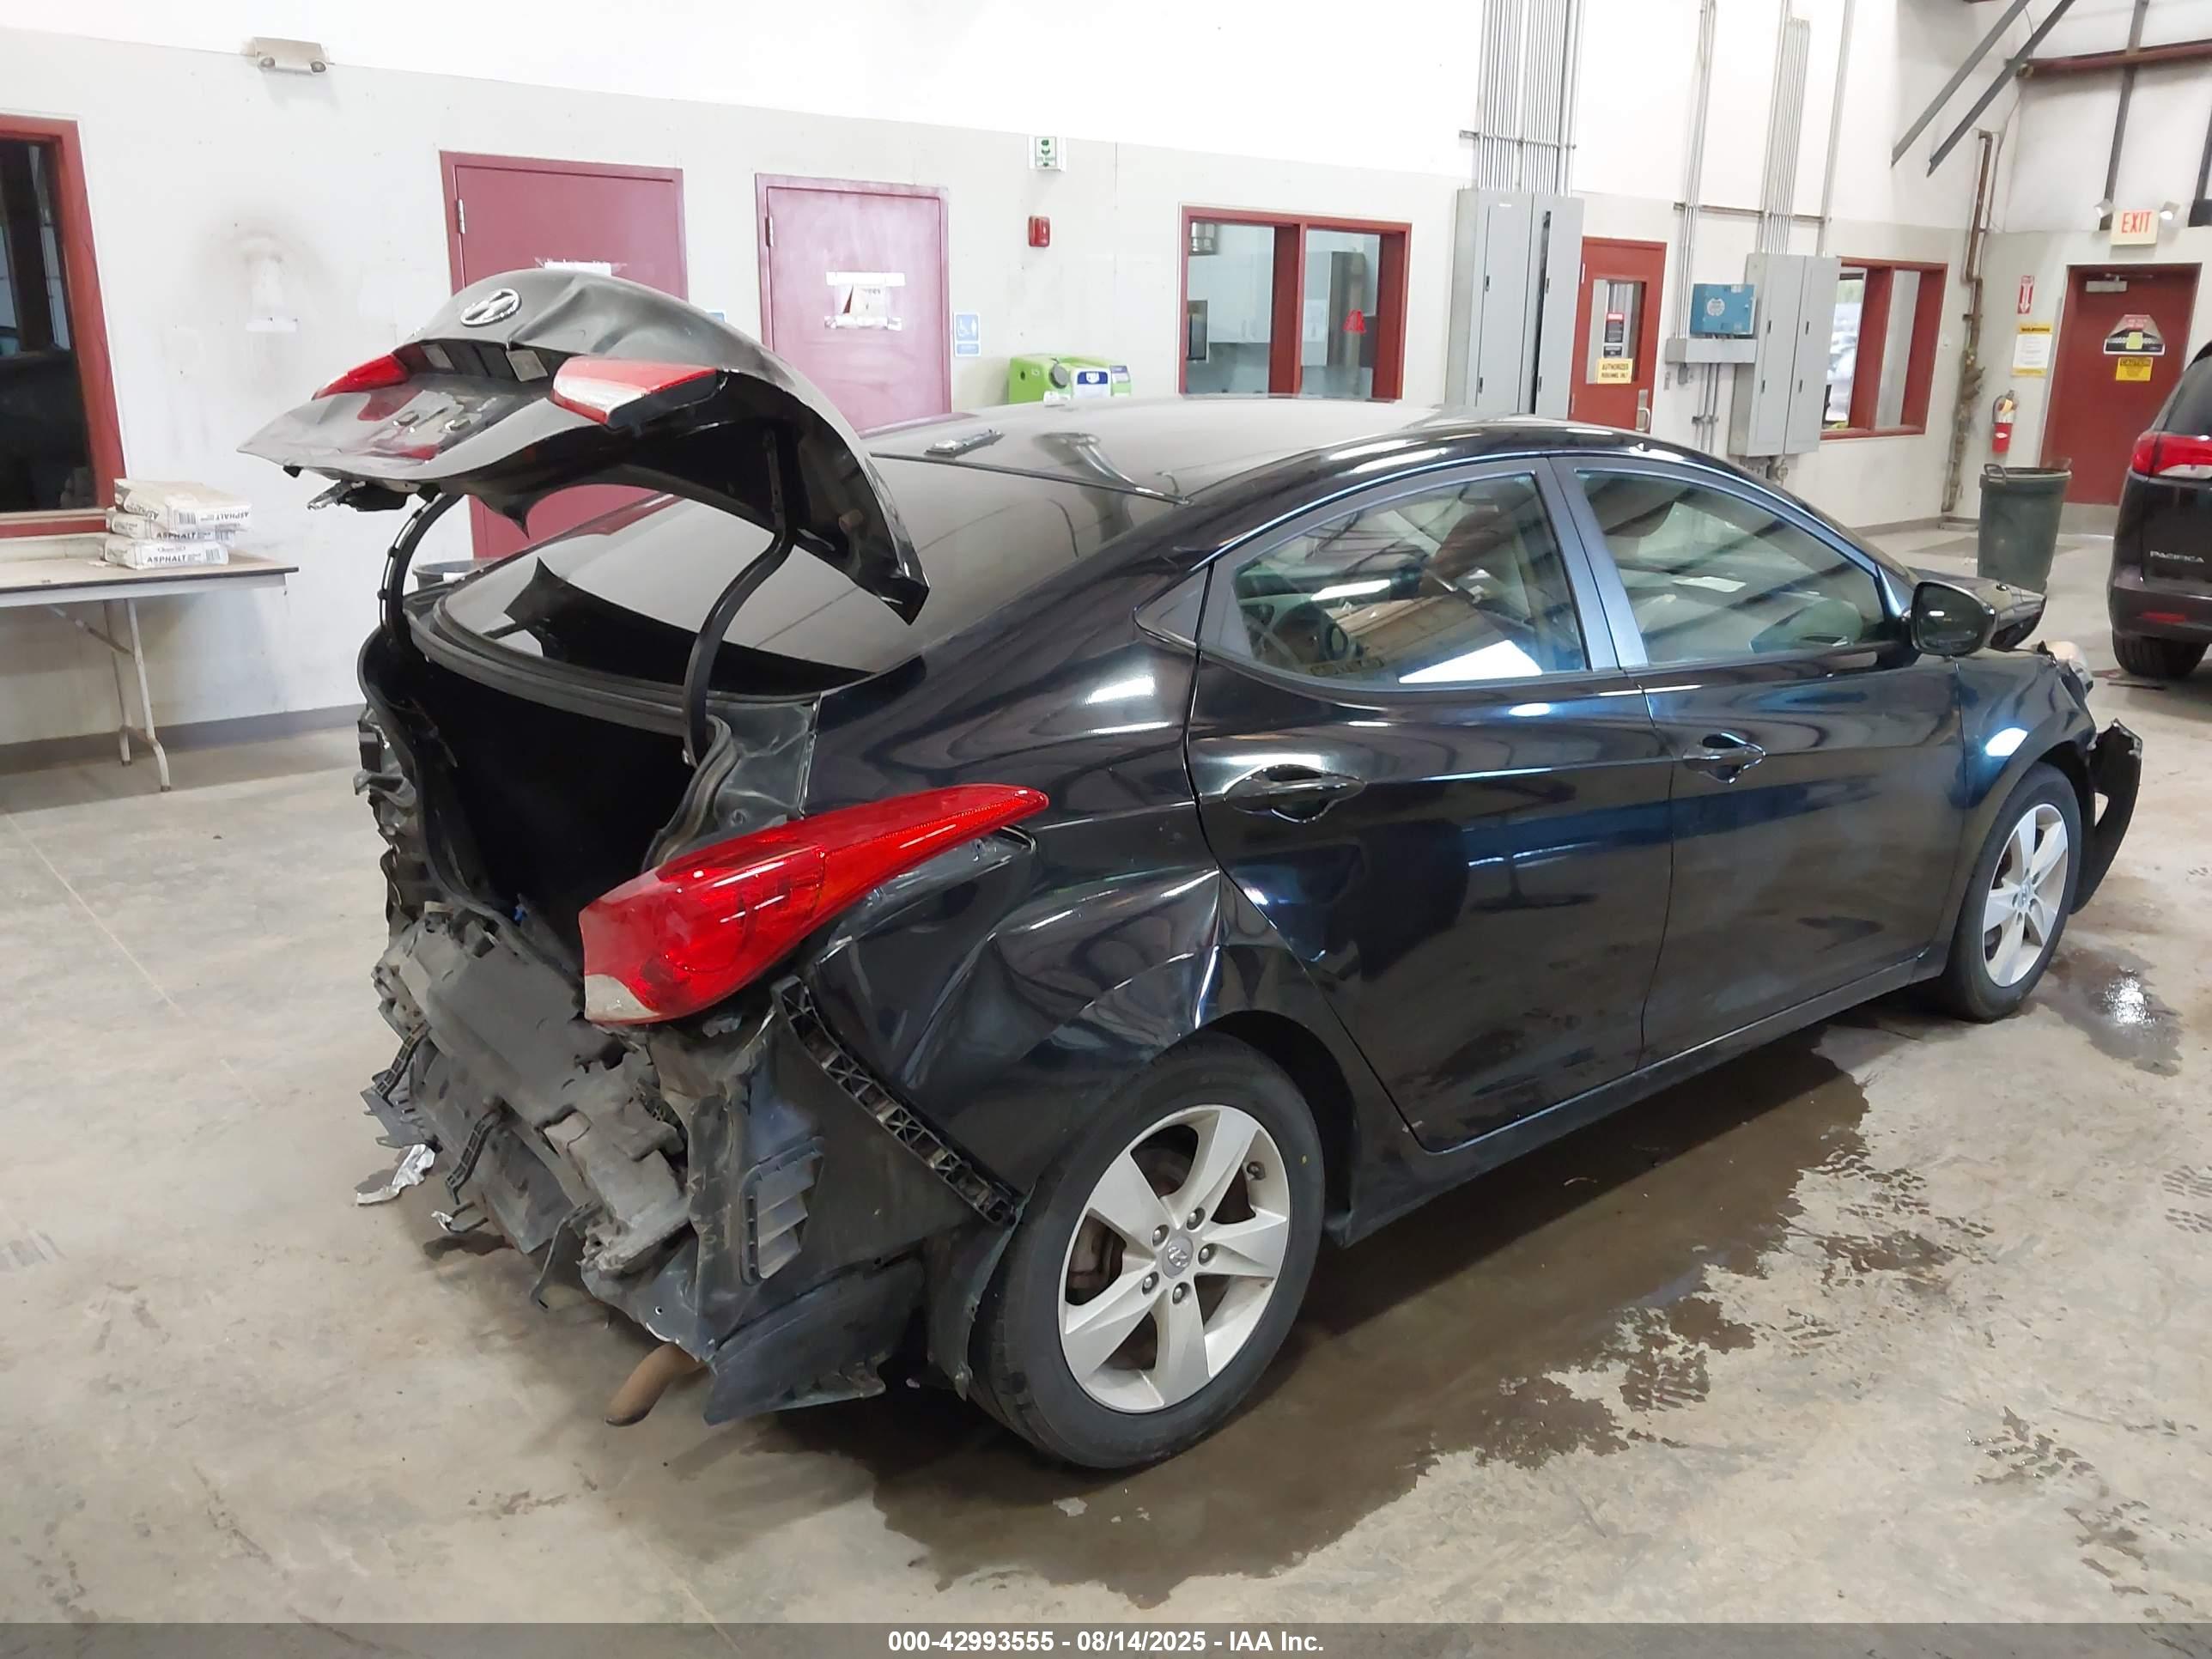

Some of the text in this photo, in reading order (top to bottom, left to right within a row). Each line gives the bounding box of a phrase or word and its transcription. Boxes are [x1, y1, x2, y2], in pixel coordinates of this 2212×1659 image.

[2121, 211, 2152, 234] EXIT
[216, 511, 249, 520] ASPHALT
[155, 532, 196, 540] ASPHALT
[147, 554, 186, 563] ASPHALT
[2149, 550, 2205, 563] PACIFICA
